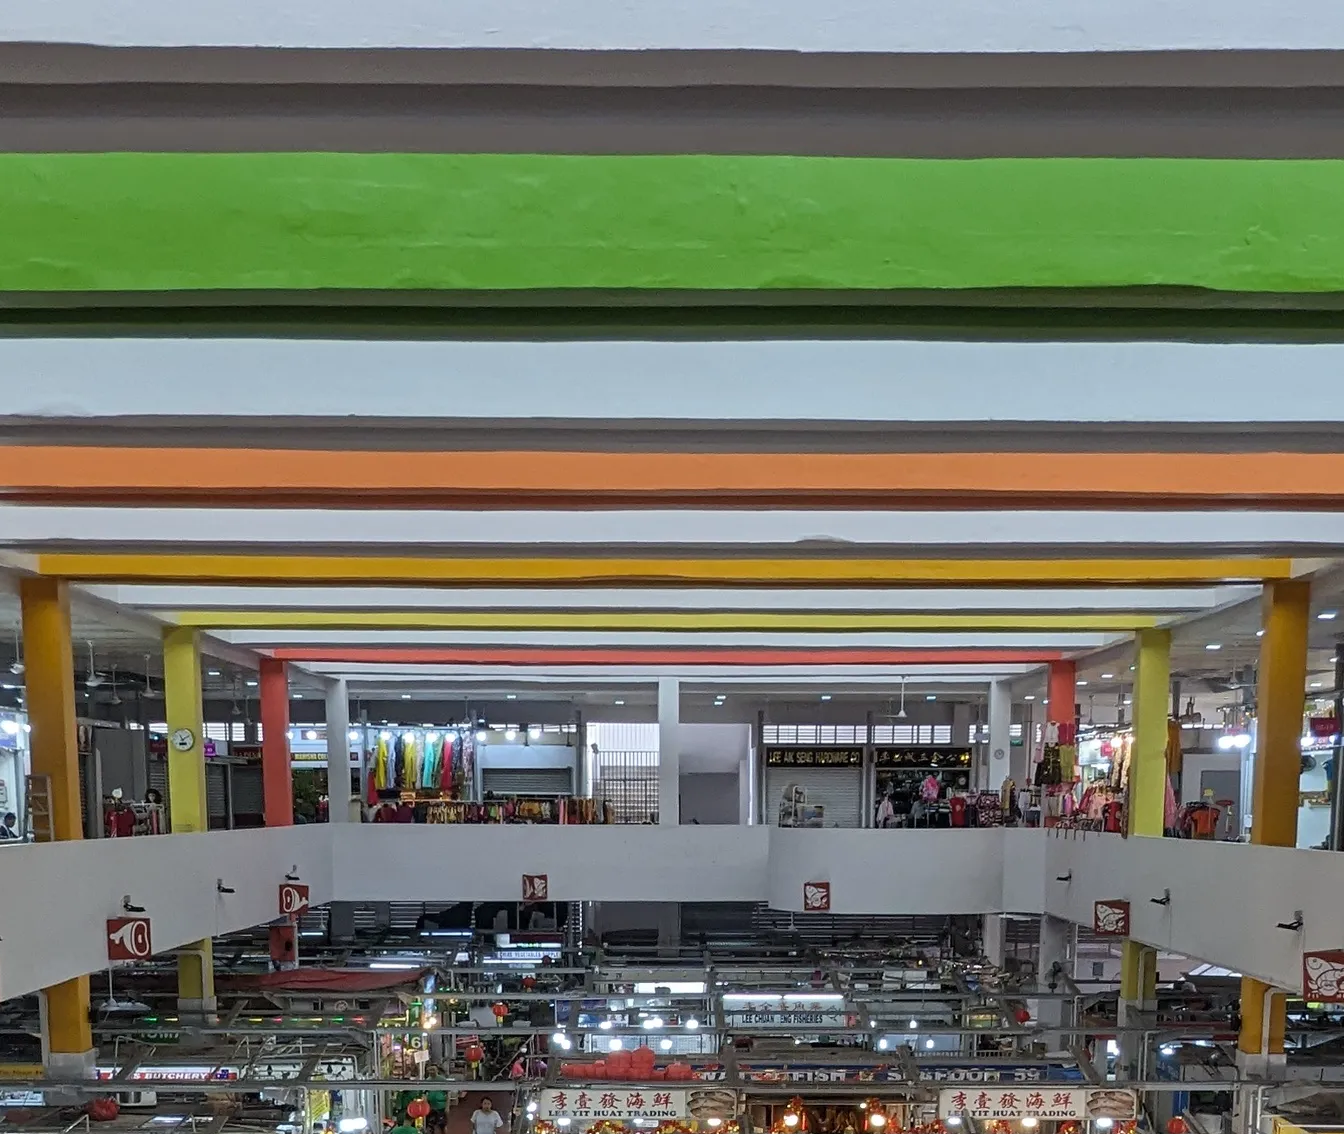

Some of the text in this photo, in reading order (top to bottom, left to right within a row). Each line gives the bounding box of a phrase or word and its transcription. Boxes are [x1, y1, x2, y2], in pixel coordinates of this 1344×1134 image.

[144, 1072, 208, 1080] BUTCHERY
[548, 1109, 677, 1118] LEE YIT HUAT TRADING
